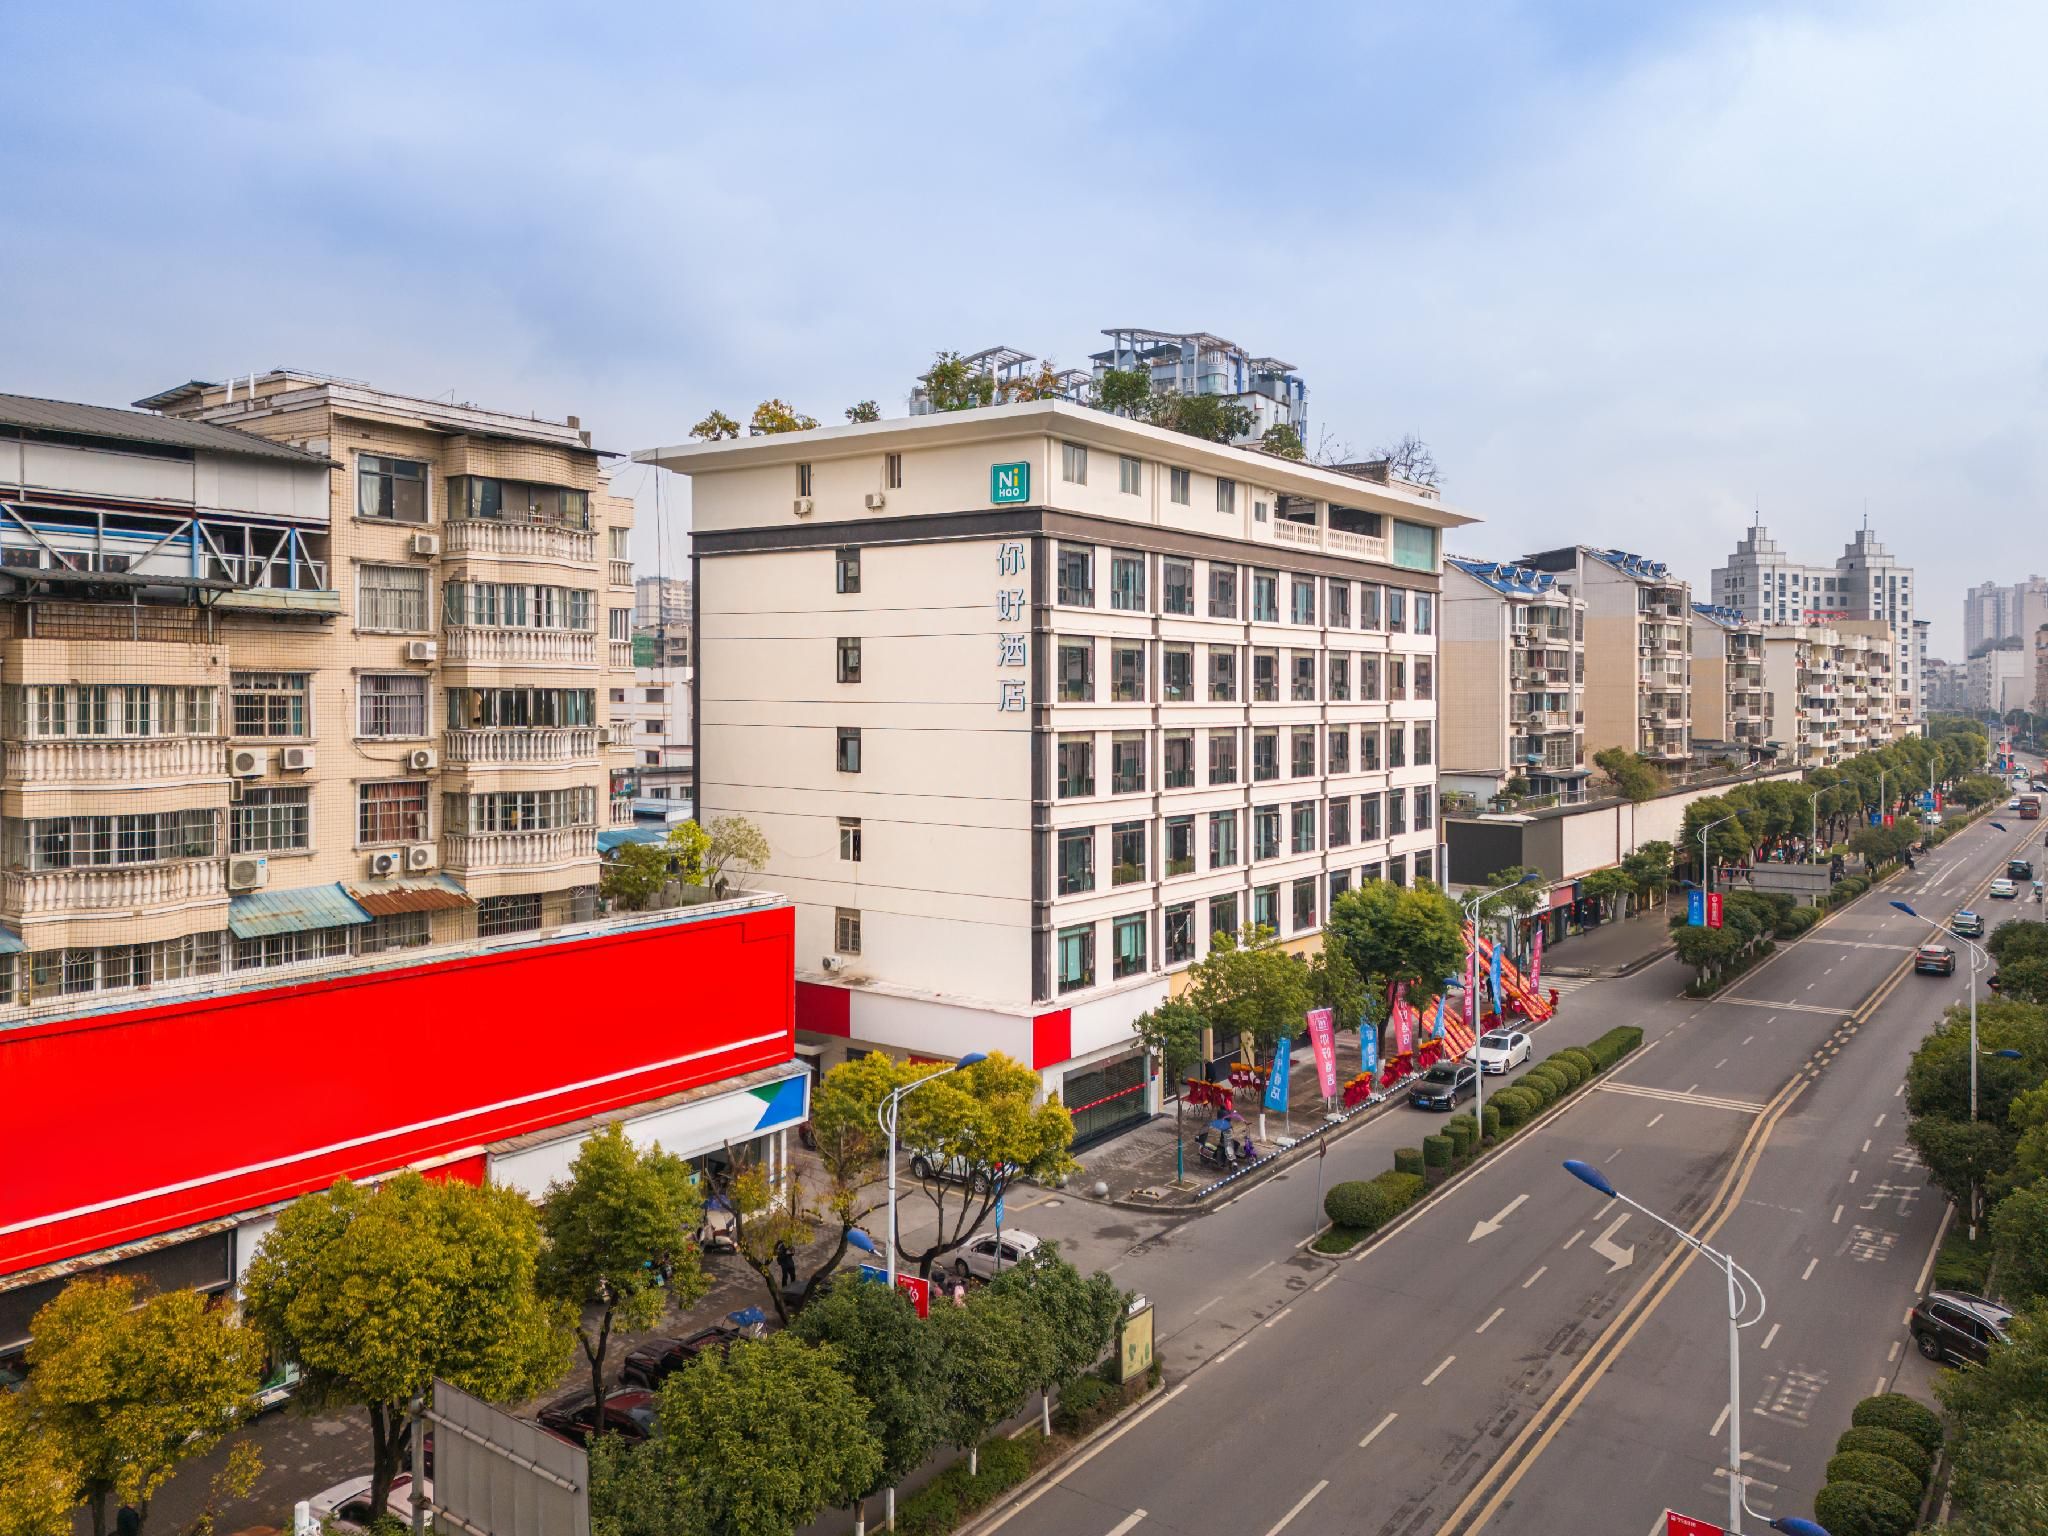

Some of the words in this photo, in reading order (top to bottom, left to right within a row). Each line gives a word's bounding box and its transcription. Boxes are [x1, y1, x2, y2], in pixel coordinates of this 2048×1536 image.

[1000, 468, 1019, 488] Ni
[997, 542, 1026, 712] 你好酒店
